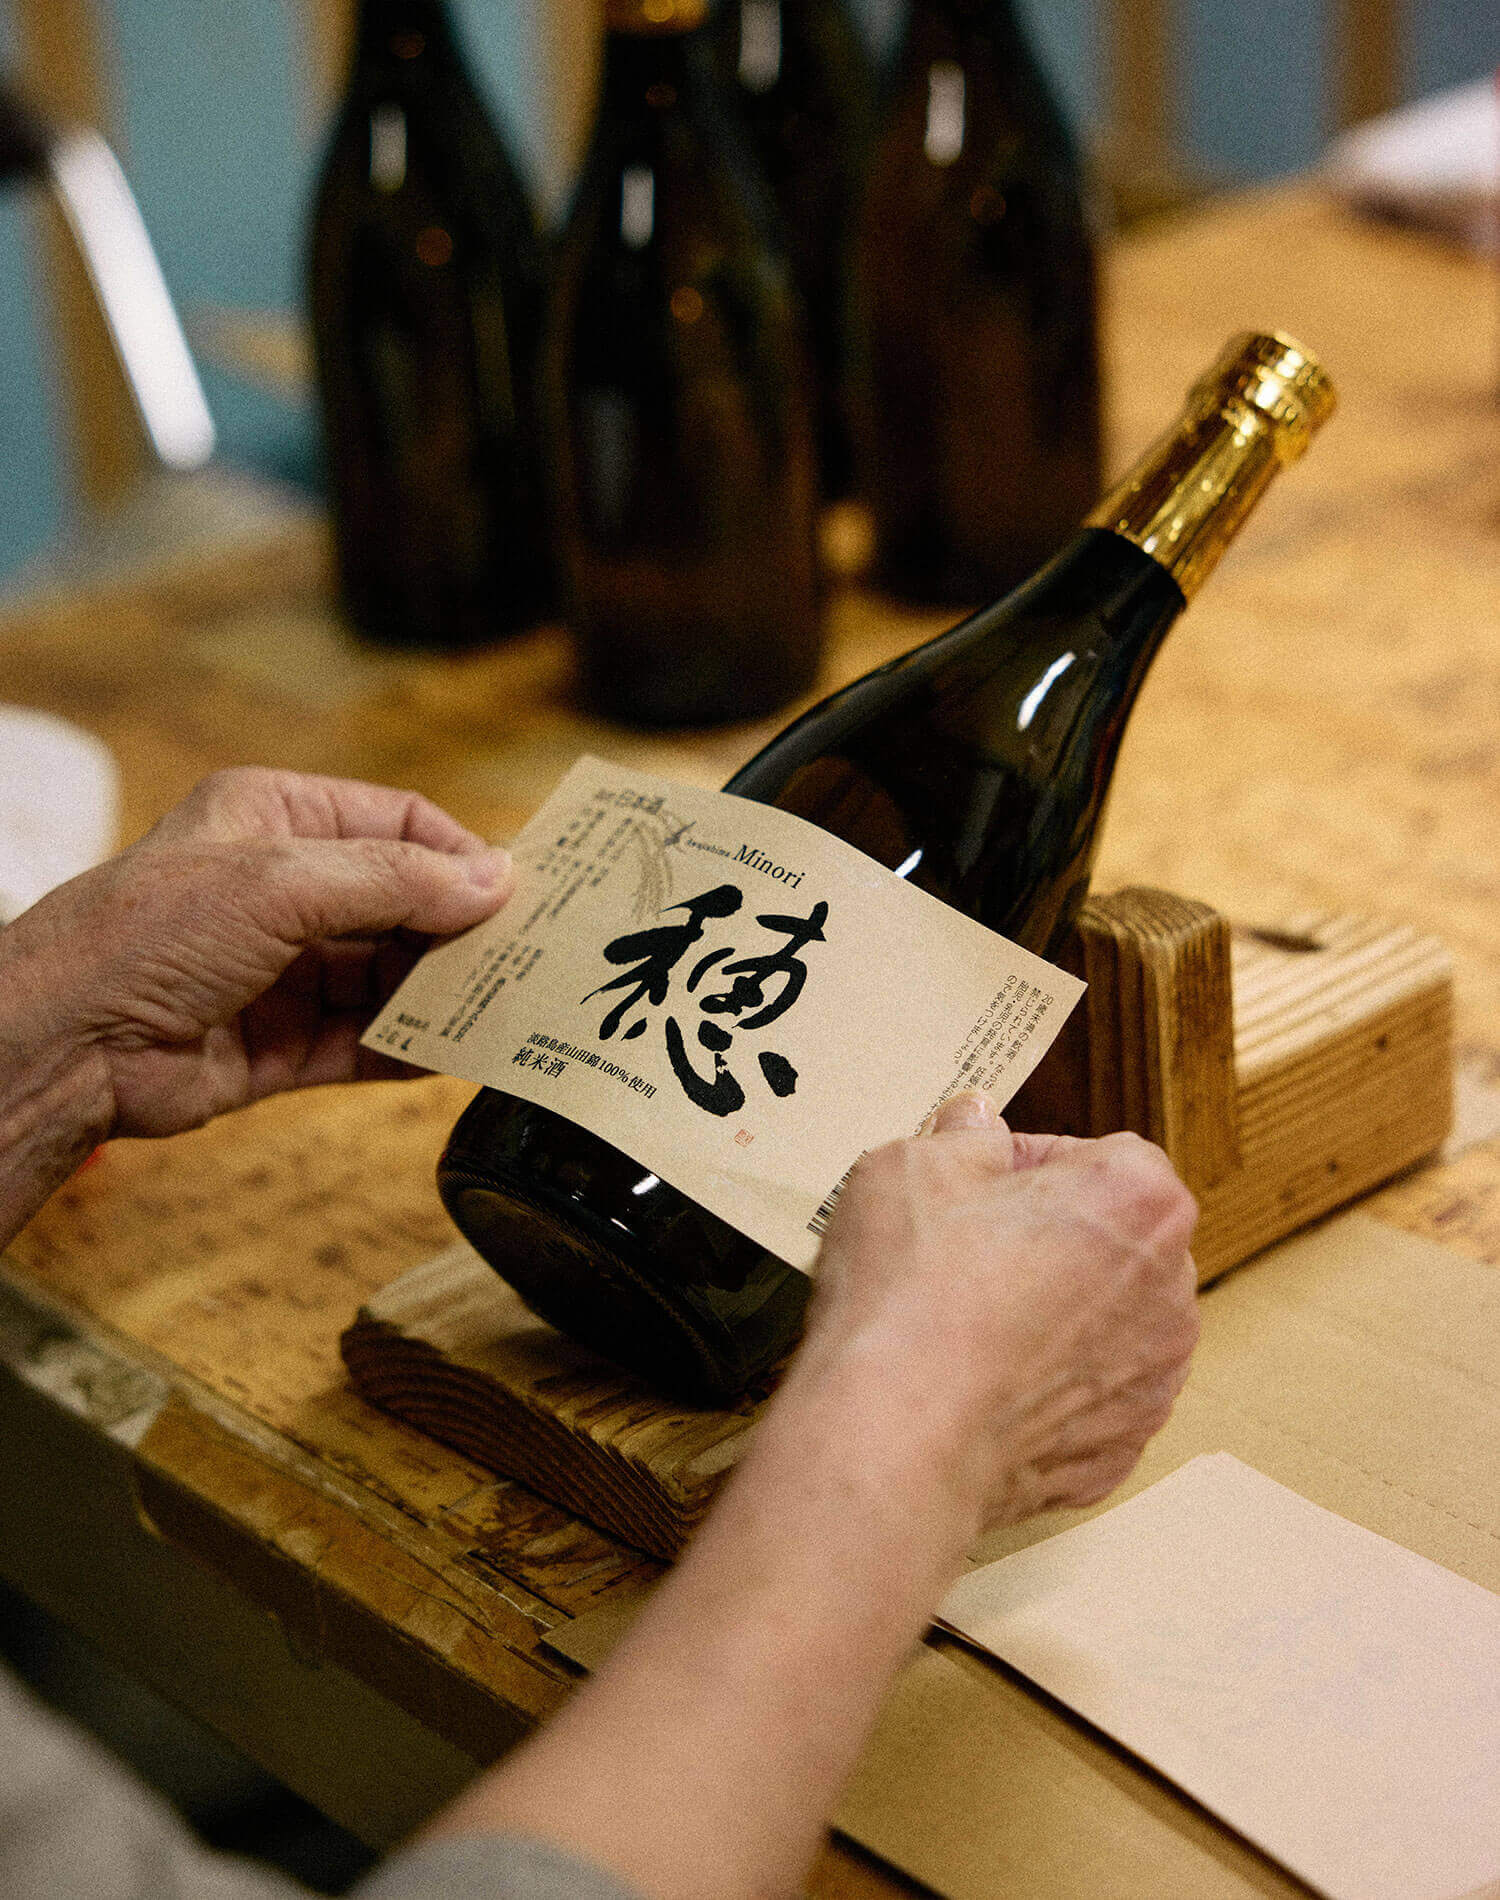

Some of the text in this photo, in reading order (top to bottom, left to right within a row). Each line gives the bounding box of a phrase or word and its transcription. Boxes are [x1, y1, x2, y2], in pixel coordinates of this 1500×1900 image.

[732, 844, 806, 890] Minori
[511, 1046, 569, 1079] 純米酒
